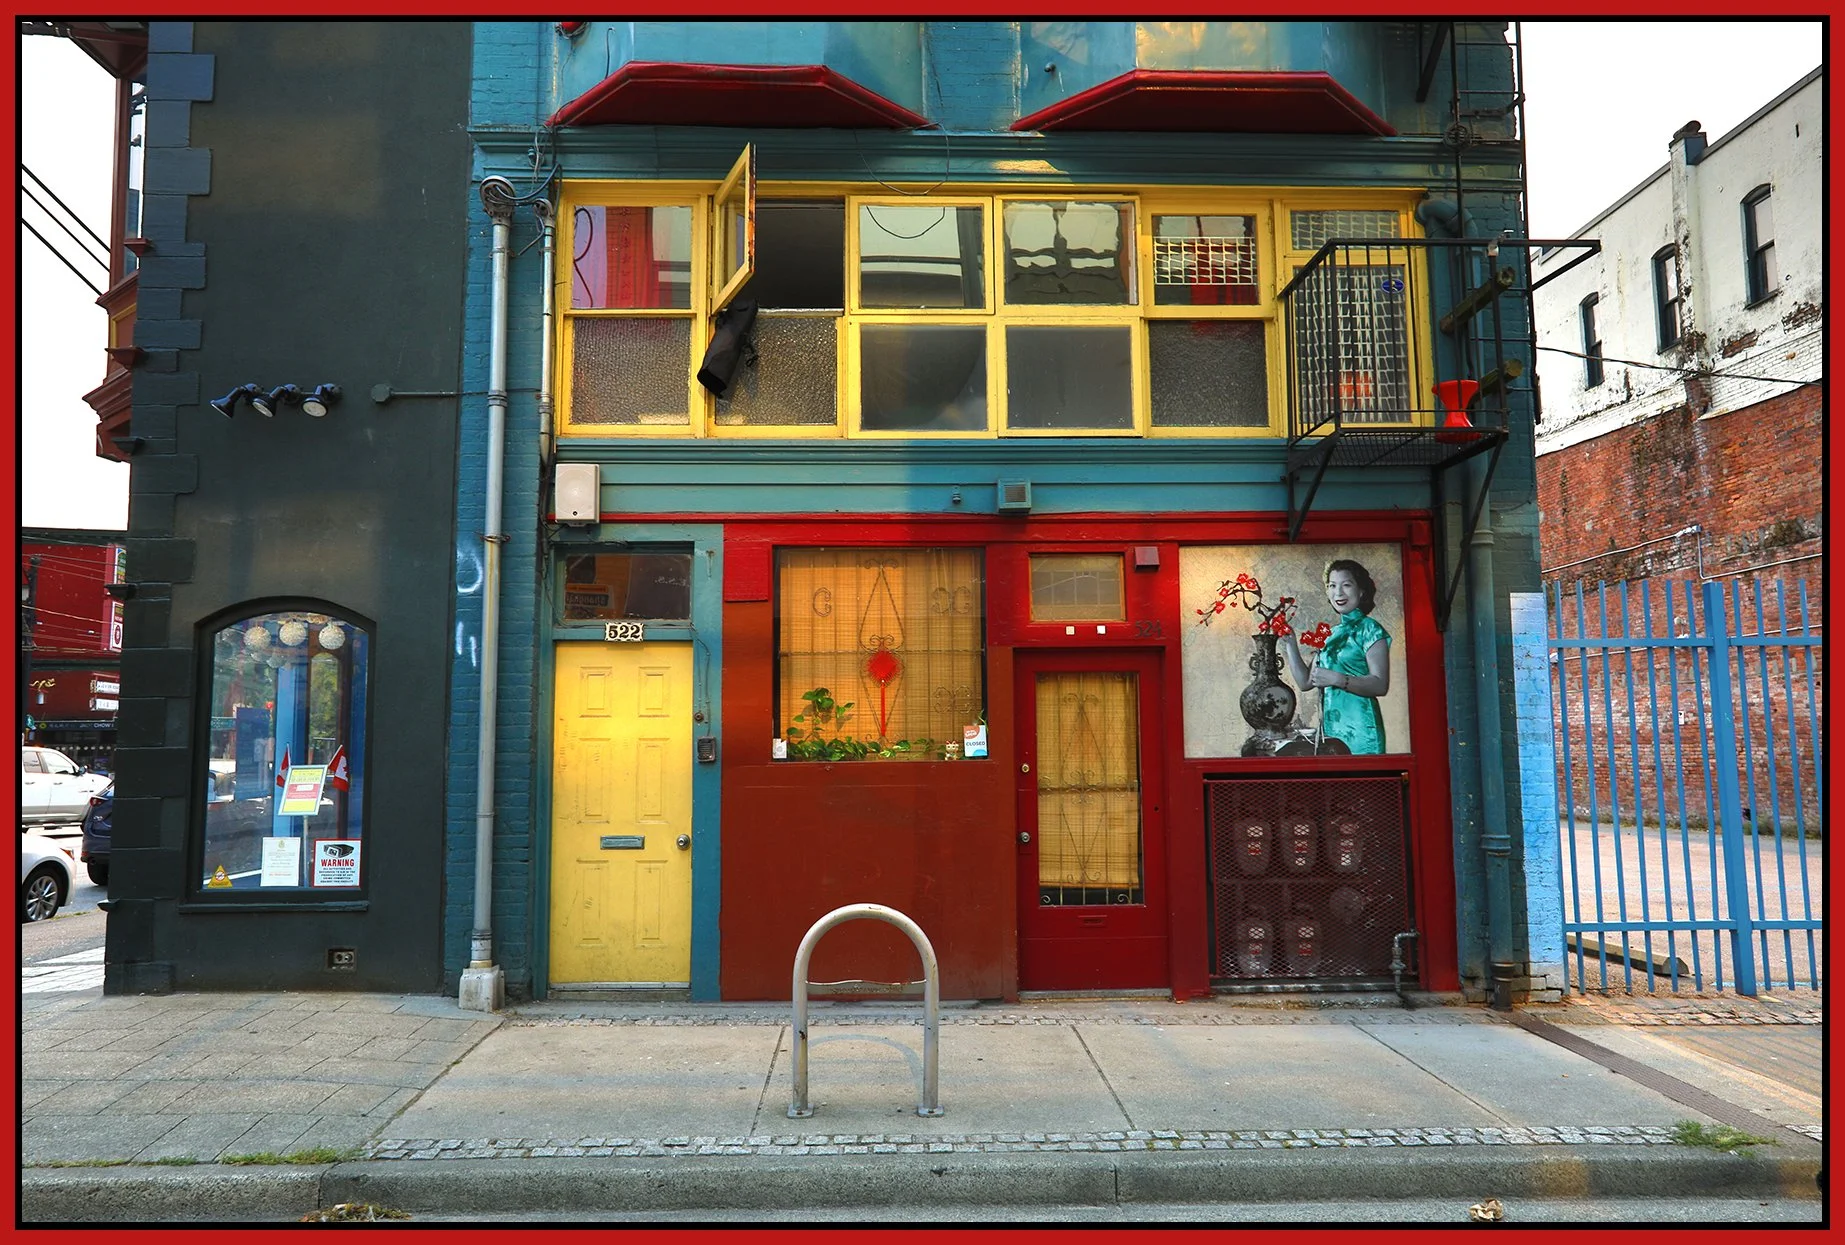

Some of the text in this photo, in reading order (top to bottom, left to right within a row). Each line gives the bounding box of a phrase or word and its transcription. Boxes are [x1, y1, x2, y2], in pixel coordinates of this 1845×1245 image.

[608, 624, 641, 639] 522
[1135, 619, 1163, 637] 524
[321, 859, 355, 867] WARNING
